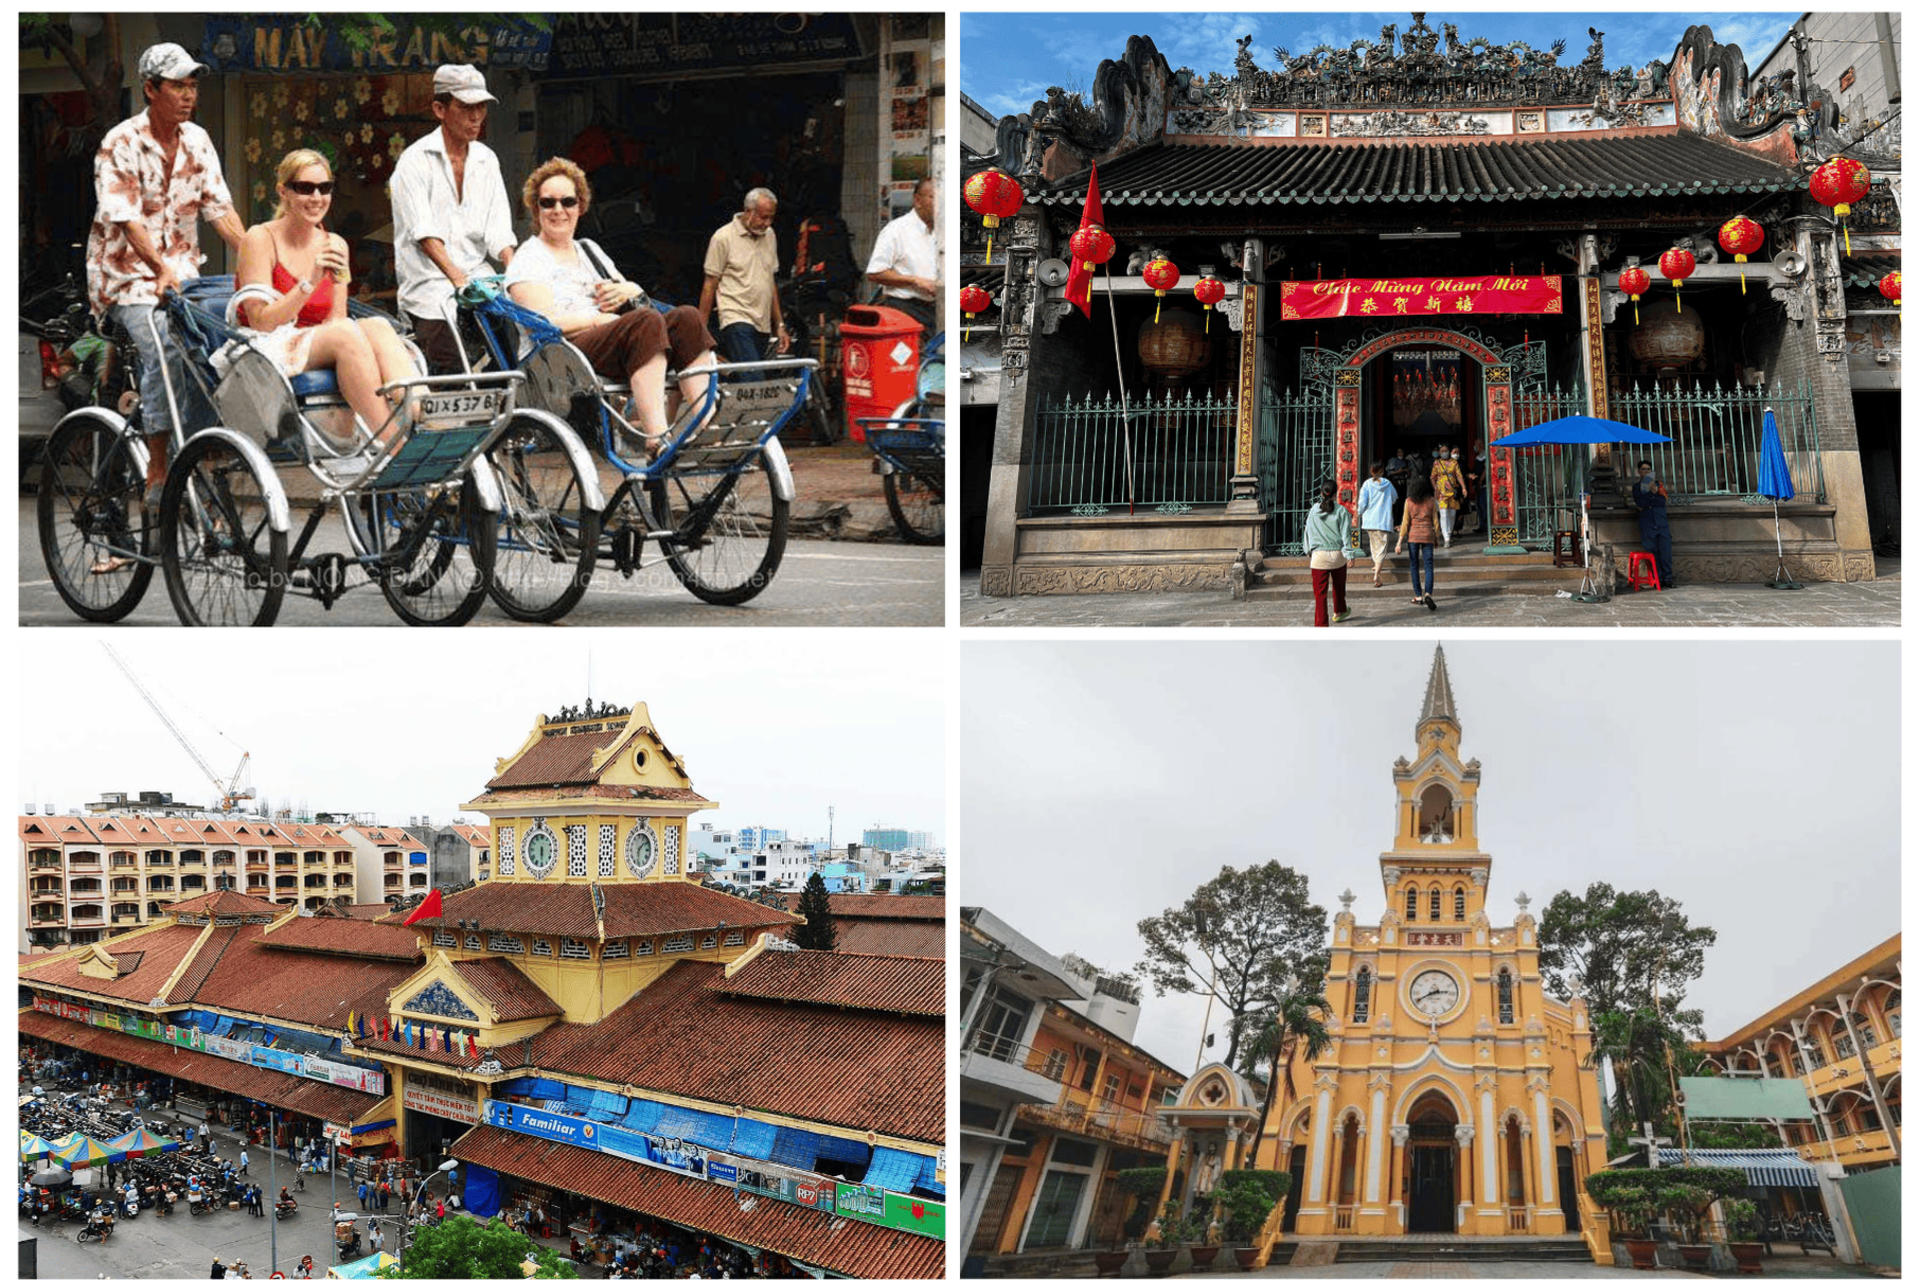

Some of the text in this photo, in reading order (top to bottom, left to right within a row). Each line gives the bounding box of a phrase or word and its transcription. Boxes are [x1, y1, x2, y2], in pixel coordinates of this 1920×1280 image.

[1365, 280, 1424, 295] Mừng
[1431, 279, 1483, 292] Năm
[1487, 278, 1529, 291] Mới
[1360, 295, 1474, 314] 恭賀新禧
[521, 1113, 576, 1136] Familiar
[797, 1188, 816, 1201] RP7
